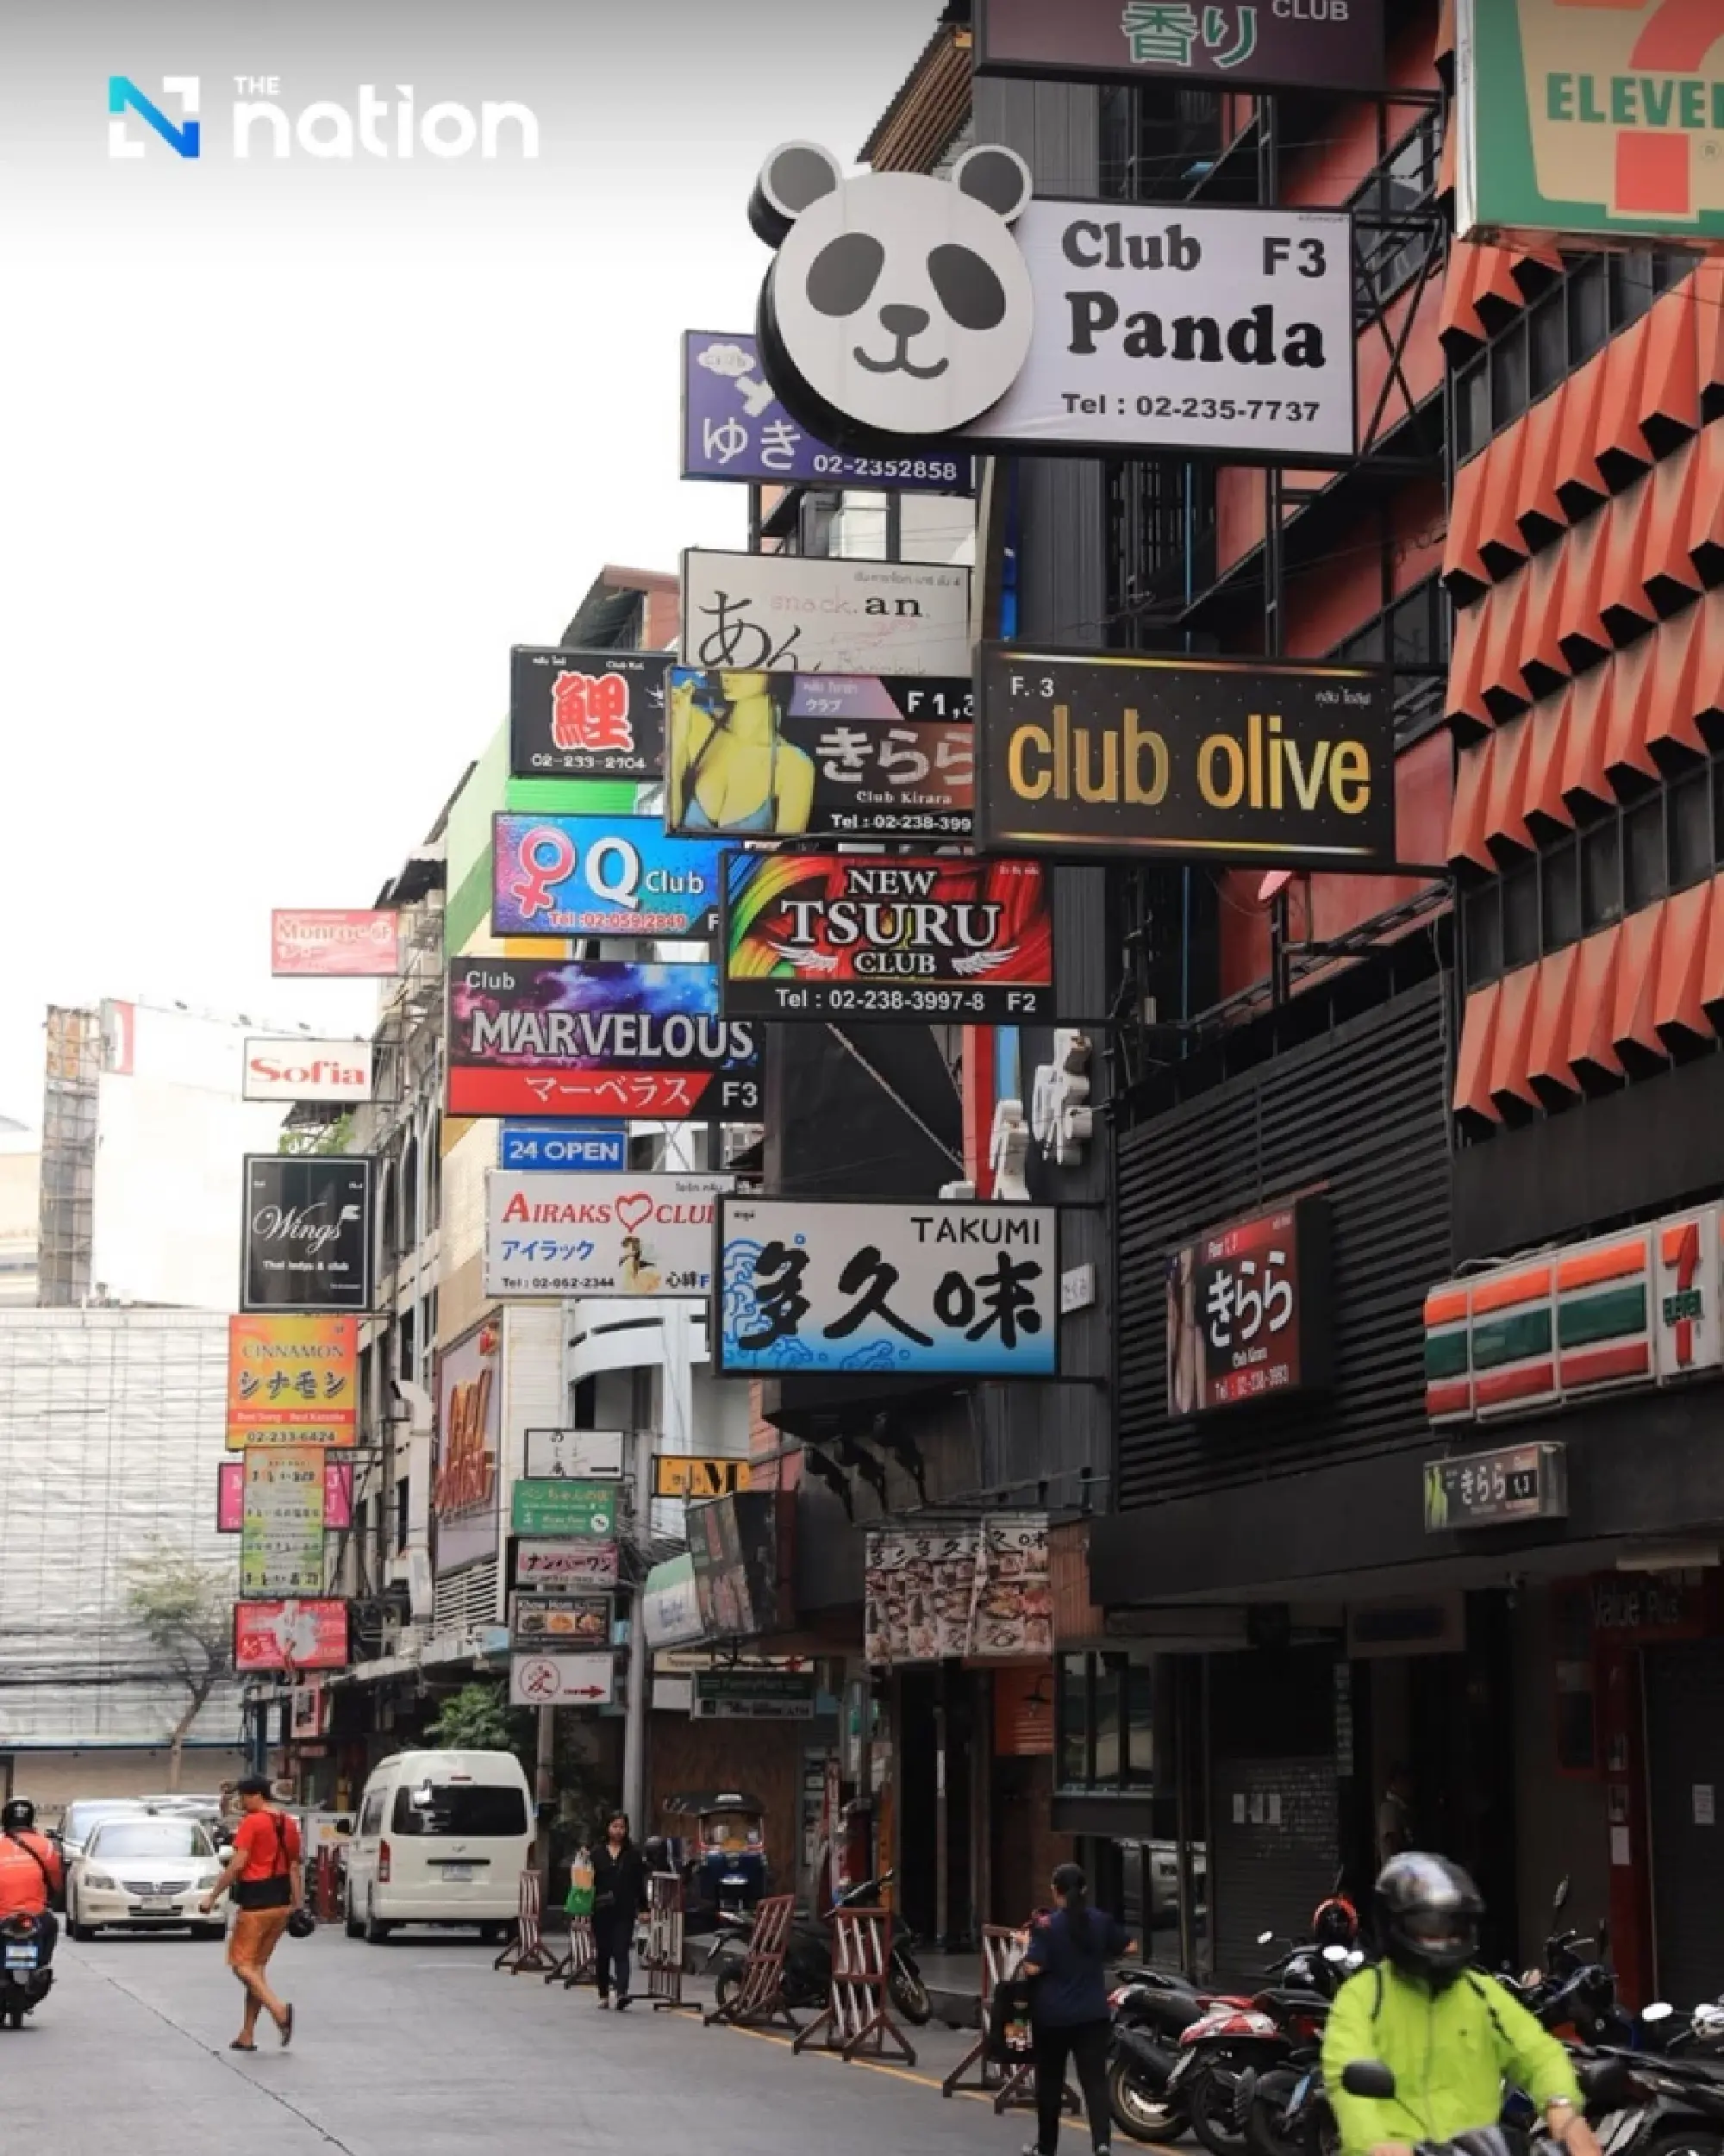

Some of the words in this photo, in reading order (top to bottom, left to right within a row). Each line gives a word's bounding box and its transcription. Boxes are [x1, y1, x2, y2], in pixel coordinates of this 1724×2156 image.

[1272, 0, 1349, 20] CLUB
[1120, 2, 1258, 68] 香り
[1062, 220, 1201, 271] Club
[1263, 237, 1326, 278] F3
[1064, 291, 1327, 368] Panda
[1062, 393, 1105, 415] Tel
[1136, 396, 1321, 421] 02-235-7737
[703, 417, 801, 470] ゆき
[814, 455, 957, 480] 02-2352858
[805, 699, 843, 713] クラブ
[816, 727, 973, 784] きらら
[1008, 704, 1169, 805] club
[1197, 714, 1371, 814] olive
[856, 791, 895, 803] Club
[901, 791, 953, 804] Kirara
[829, 814, 857, 828] Tel
[585, 837, 639, 909] Q
[647, 870, 704, 894] Club
[847, 870, 938, 895] NEW
[781, 900, 1001, 947] TSURU
[853, 952, 937, 973] CLUB
[465, 971, 515, 991] Club
[776, 989, 807, 1008] Tel
[829, 990, 985, 1011] 02-238-3997-8
[1008, 993, 1036, 1012] F2
[472, 1009, 753, 1058] MARVELOUS
[250, 1057, 365, 1085] Sofia
[524, 1076, 690, 1109] マーベラス
[722, 1081, 759, 1108] F3
[509, 1140, 538, 1161] 24
[544, 1141, 620, 1161] OPEN
[501, 1191, 611, 1224] AIRAKS
[253, 1203, 343, 1256] Wings
[911, 1217, 1040, 1244] TAKUMI
[501, 1240, 595, 1261] アイラック
[738, 1241, 1043, 1350] 多久味
[1207, 1251, 1293, 1347] きらら
[242, 1344, 344, 1359] CINNAMON
[239, 1371, 346, 1400] シナモン
[1461, 1463, 1506, 1504] きらら
